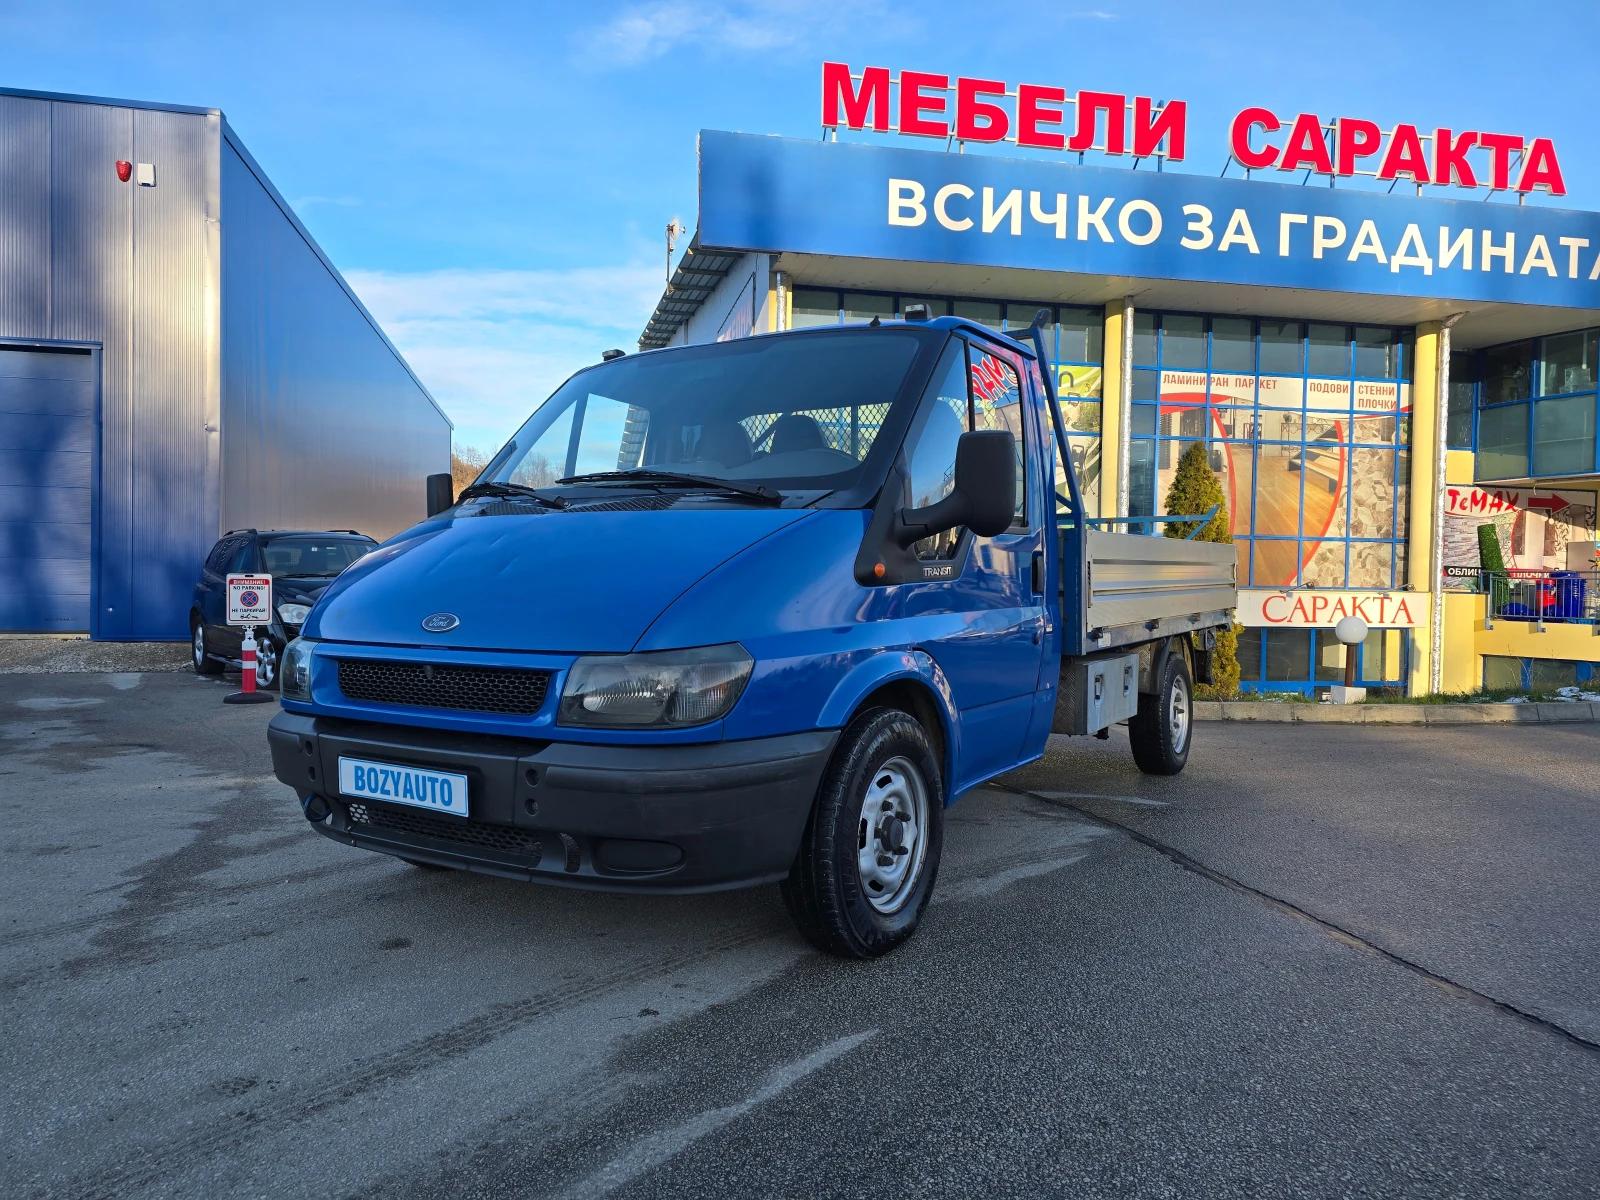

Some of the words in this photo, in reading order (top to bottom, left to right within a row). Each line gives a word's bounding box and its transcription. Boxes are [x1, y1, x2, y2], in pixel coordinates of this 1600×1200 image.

[821, 61, 1187, 162] МЕБЕЛИ
[1228, 107, 1567, 196] САРАКТА
[887, 178, 1163, 246] ВСИЧКО
[1180, 203, 1261, 254] ЗА
[1235, 377, 1278, 390] ПАРКЕТ
[1309, 382, 1349, 394] ПОДОВИ
[1358, 385, 1395, 396] СТЕННИ
[1358, 398, 1397, 410] ПЛОЧКИ
[923, 566, 952, 577] TRANSIT
[1262, 595, 1414, 624] САРАКТА
[429, 616, 450, 627] Ford
[354, 765, 453, 807] BOZYAUTO
